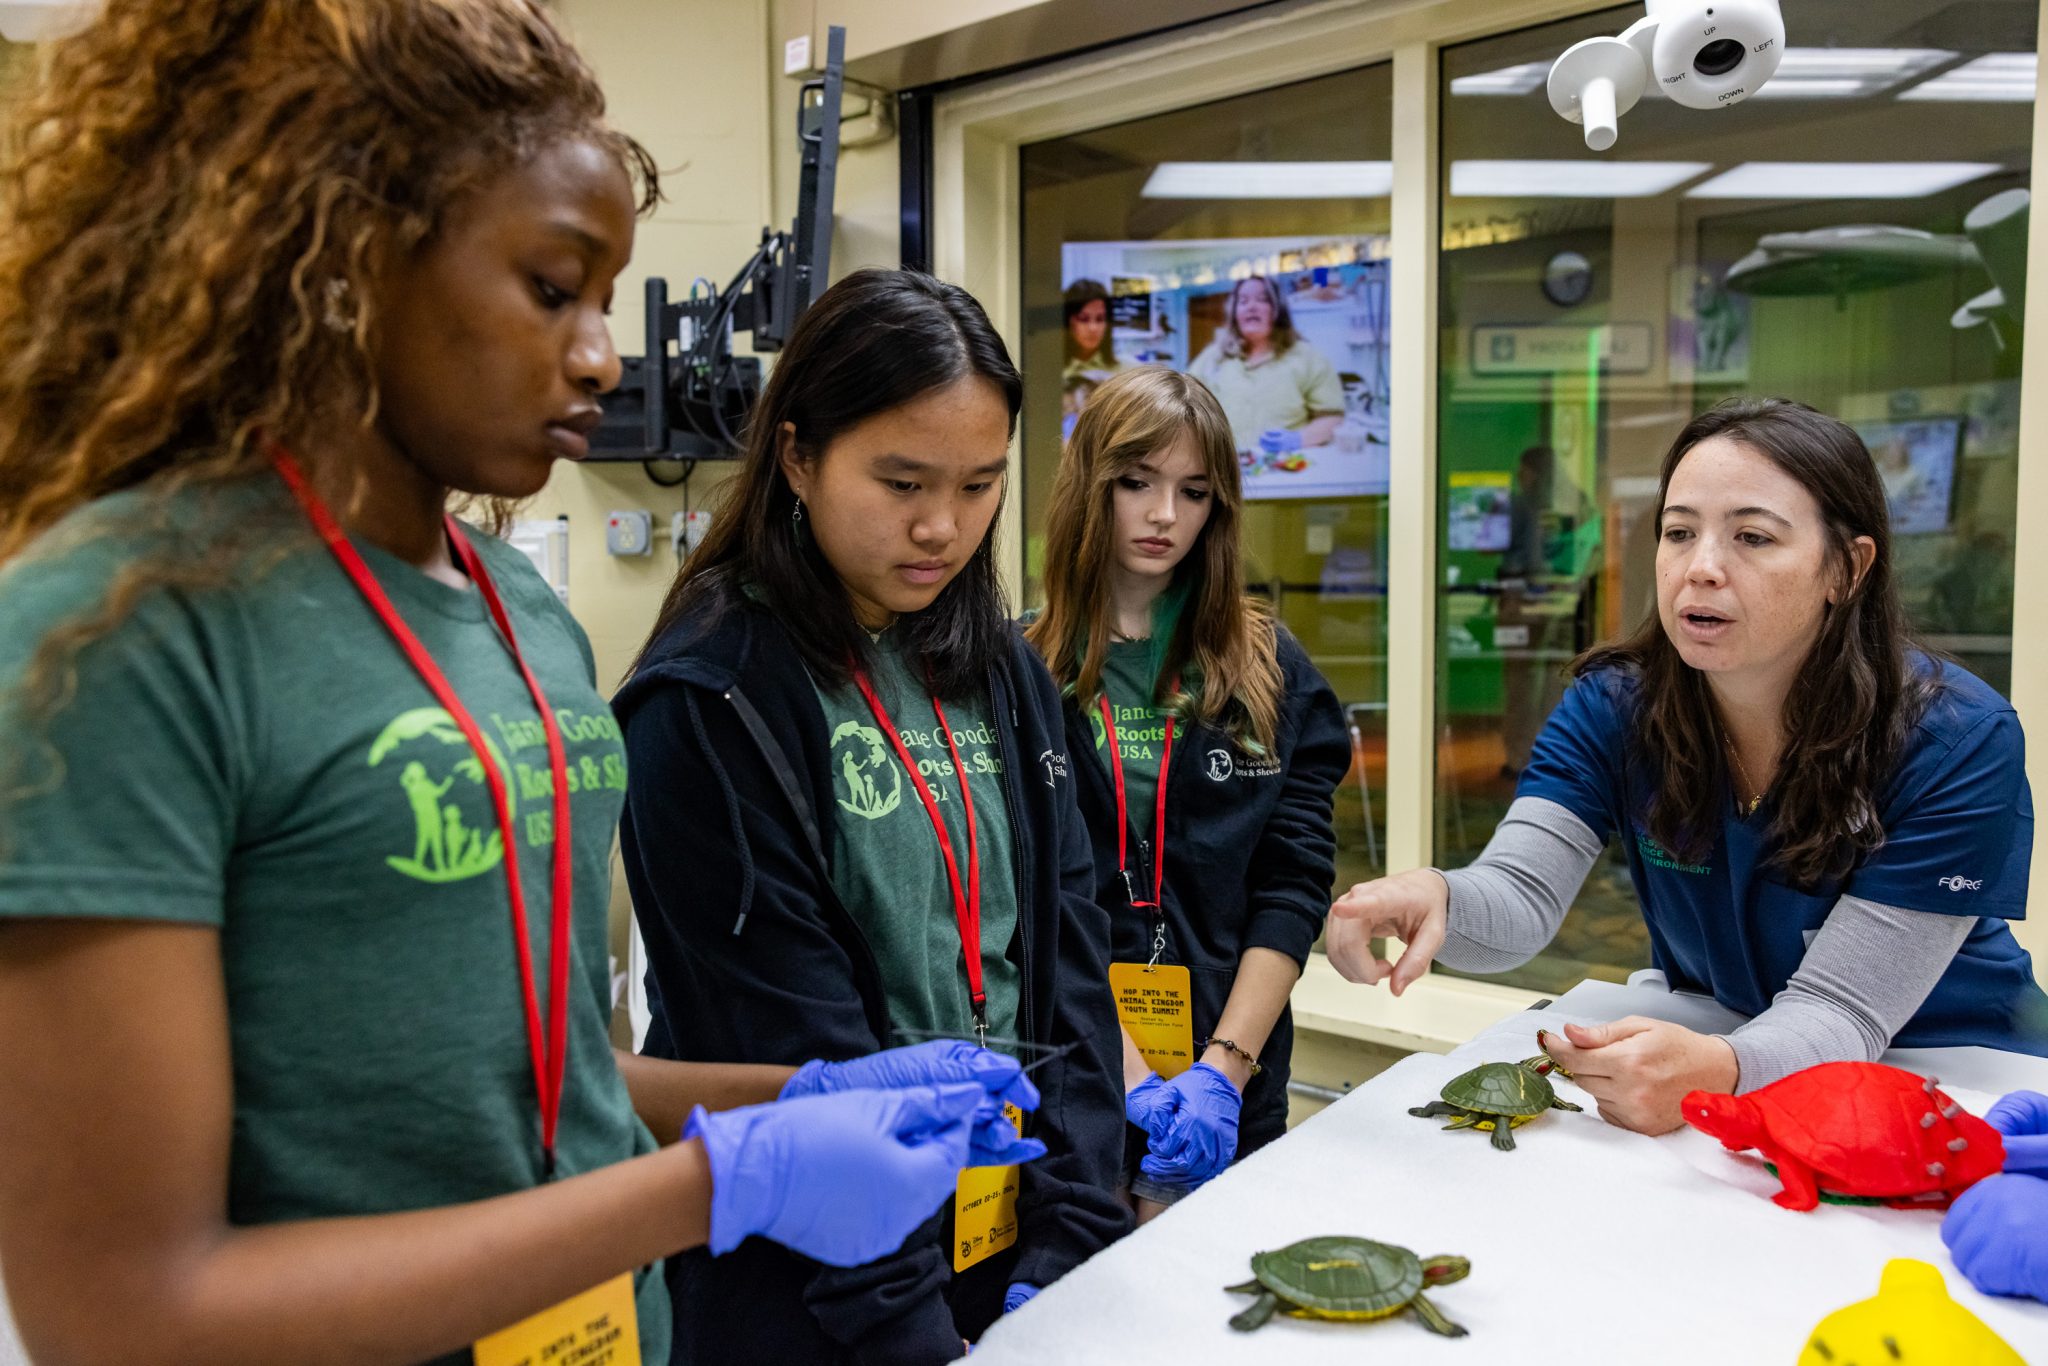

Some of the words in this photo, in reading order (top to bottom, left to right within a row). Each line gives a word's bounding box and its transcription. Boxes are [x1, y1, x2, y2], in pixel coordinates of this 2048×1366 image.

[1703, 26, 1717, 37] UP
[1753, 38, 1775, 53] LEFT
[1662, 72, 1687, 85] RIGHT
[1717, 87, 1745, 102] DOWN
[1114, 726, 1165, 741] Roots
[1118, 745, 1153, 759] USA
[580, 755, 602, 791] &
[1142, 989, 1161, 997] INTO
[1165, 990, 1179, 998] THE
[1119, 997, 1147, 1005] ANIMAL
[1151, 999, 1184, 1007] KINGDOM
[1152, 1007, 1180, 1016] SUMMIT
[962, 1198, 982, 1213] OCTOBER
